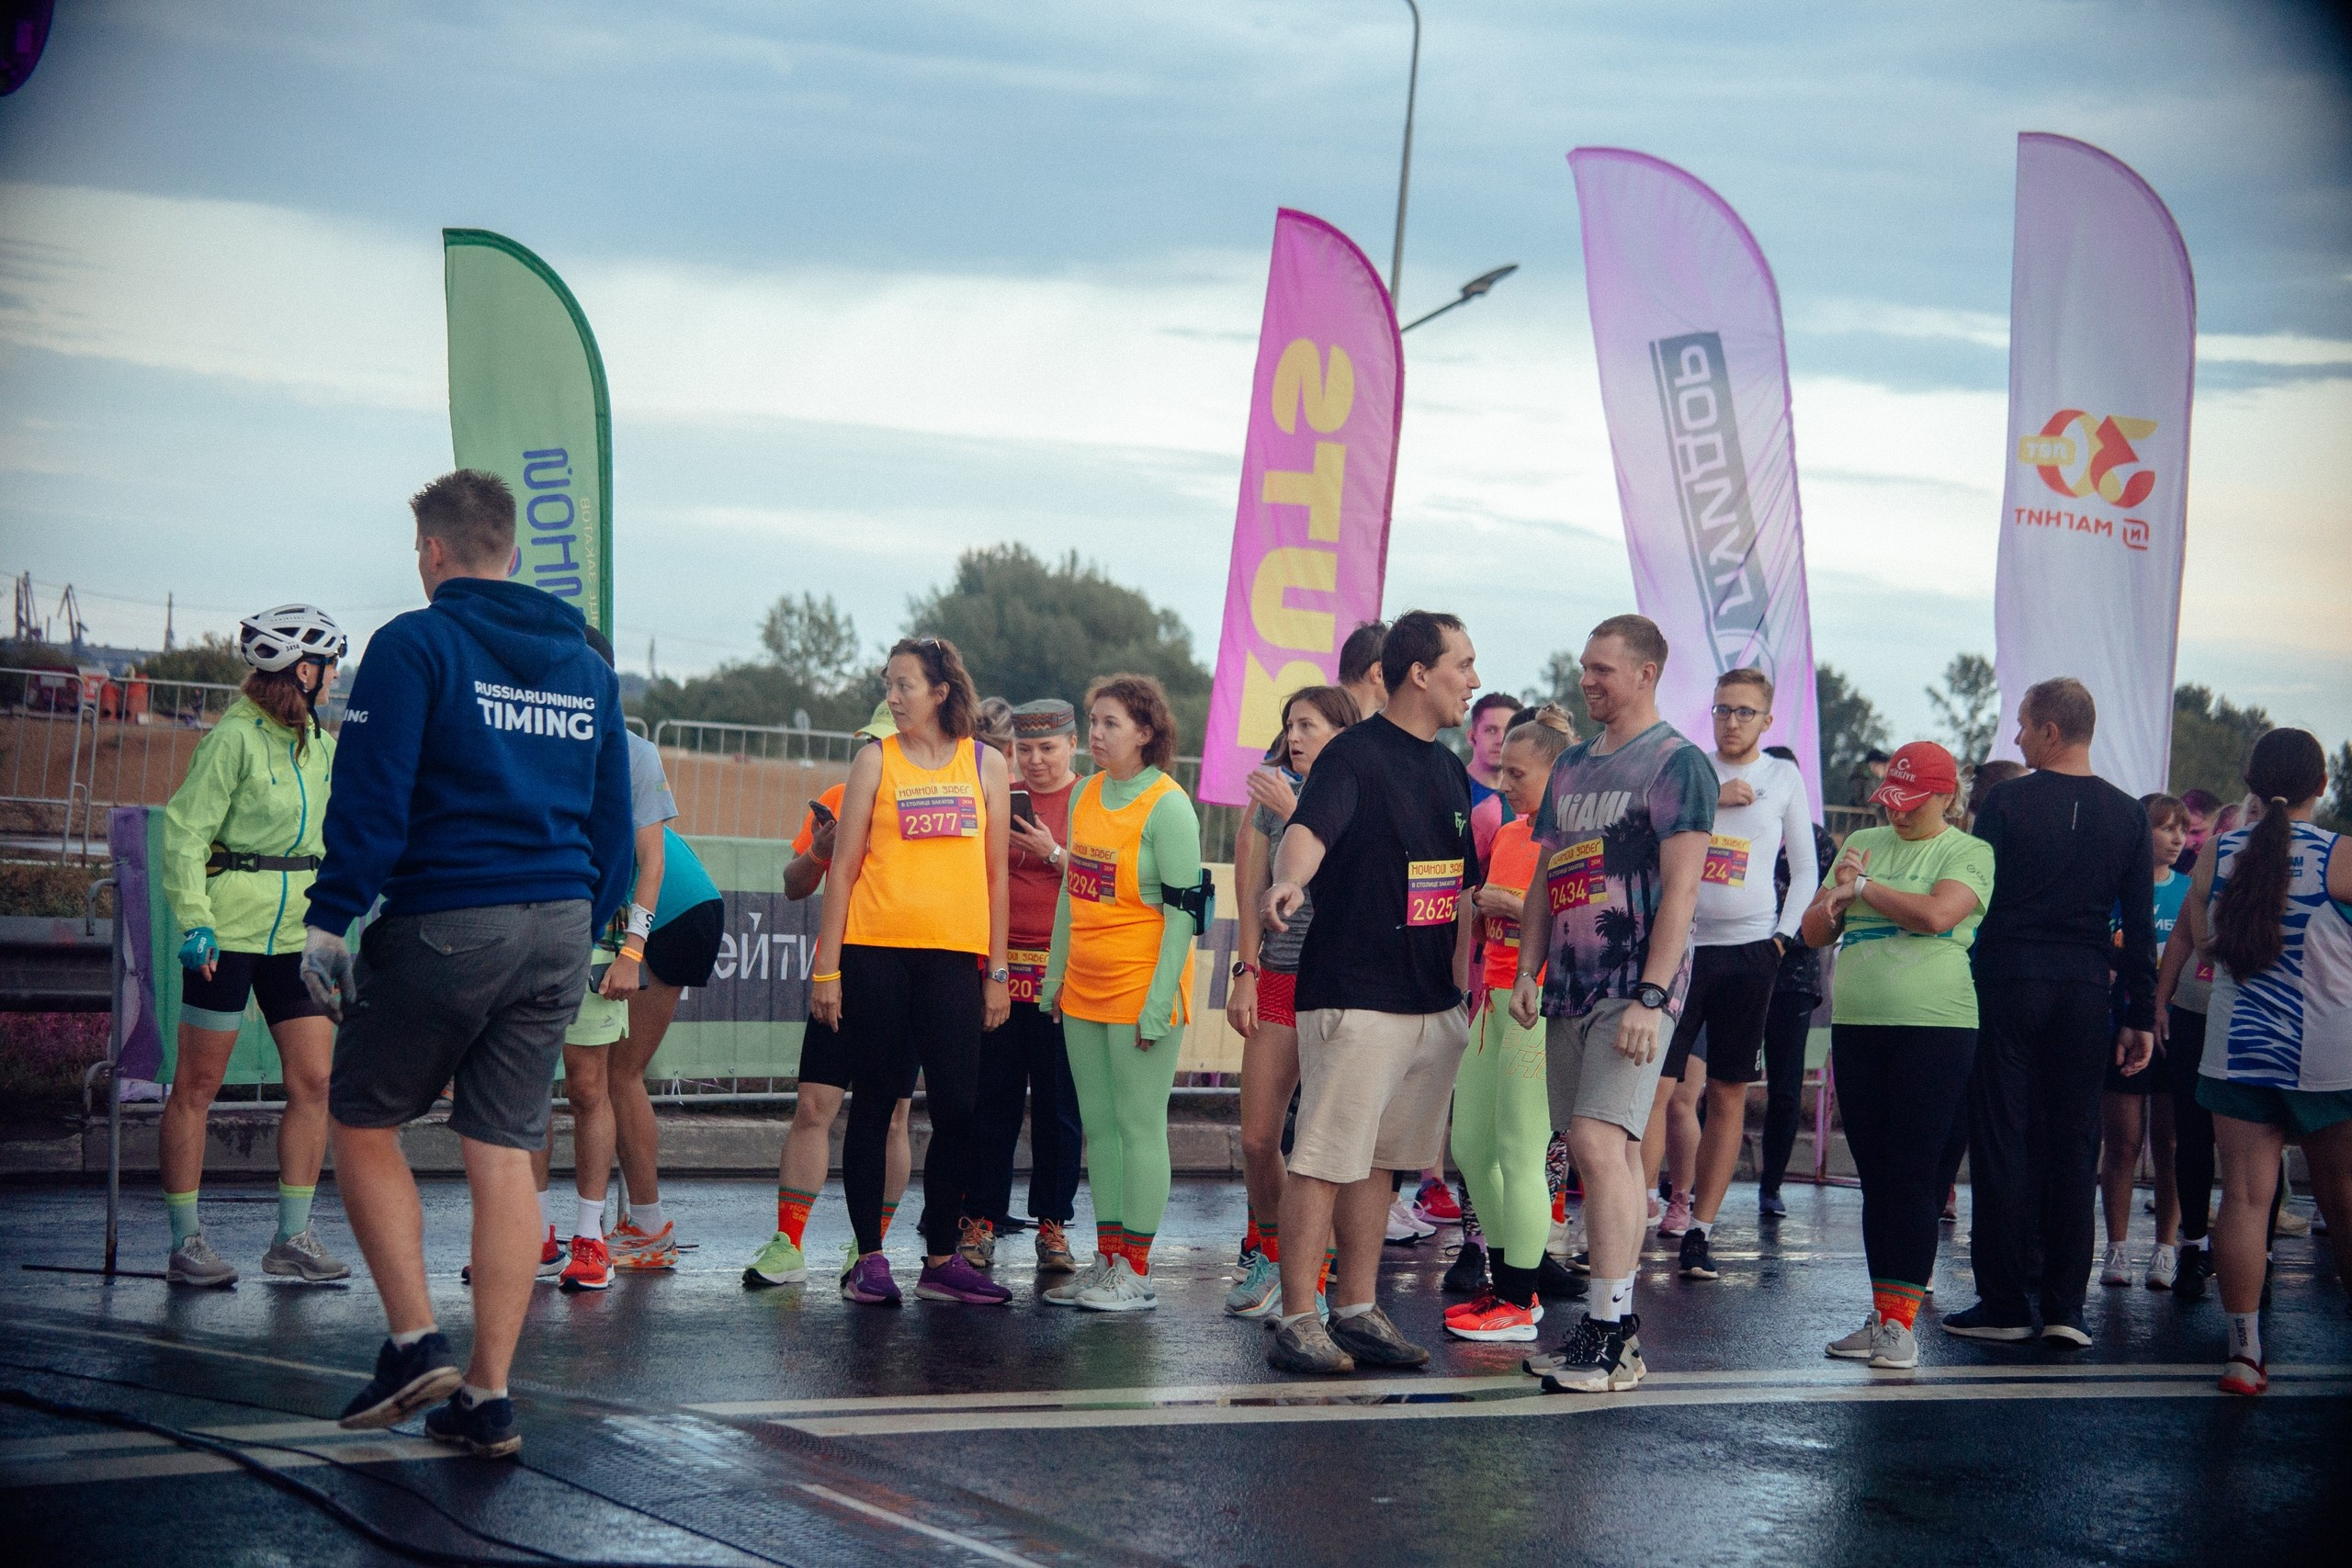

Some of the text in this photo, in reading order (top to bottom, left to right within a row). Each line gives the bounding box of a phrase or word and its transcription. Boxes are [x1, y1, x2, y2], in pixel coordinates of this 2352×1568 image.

[286, 644, 300, 652] 3414
[474, 680, 595, 710] RUSSIARUNNING
[477, 697, 594, 740] TIMING
[942, 785, 970, 795] ЗАБЕГ
[905, 812, 958, 836] 2377
[1090, 847, 1116, 861] ЗАБЕГ
[1576, 841, 1601, 857] ЗАБЕГ
[1068, 871, 1099, 897] 2294
[1551, 878, 1588, 909] 2434
[1412, 896, 1454, 921] 2625
[1022, 953, 1049, 963] ЗАБЕГ
[1010, 978, 1032, 998] 20
